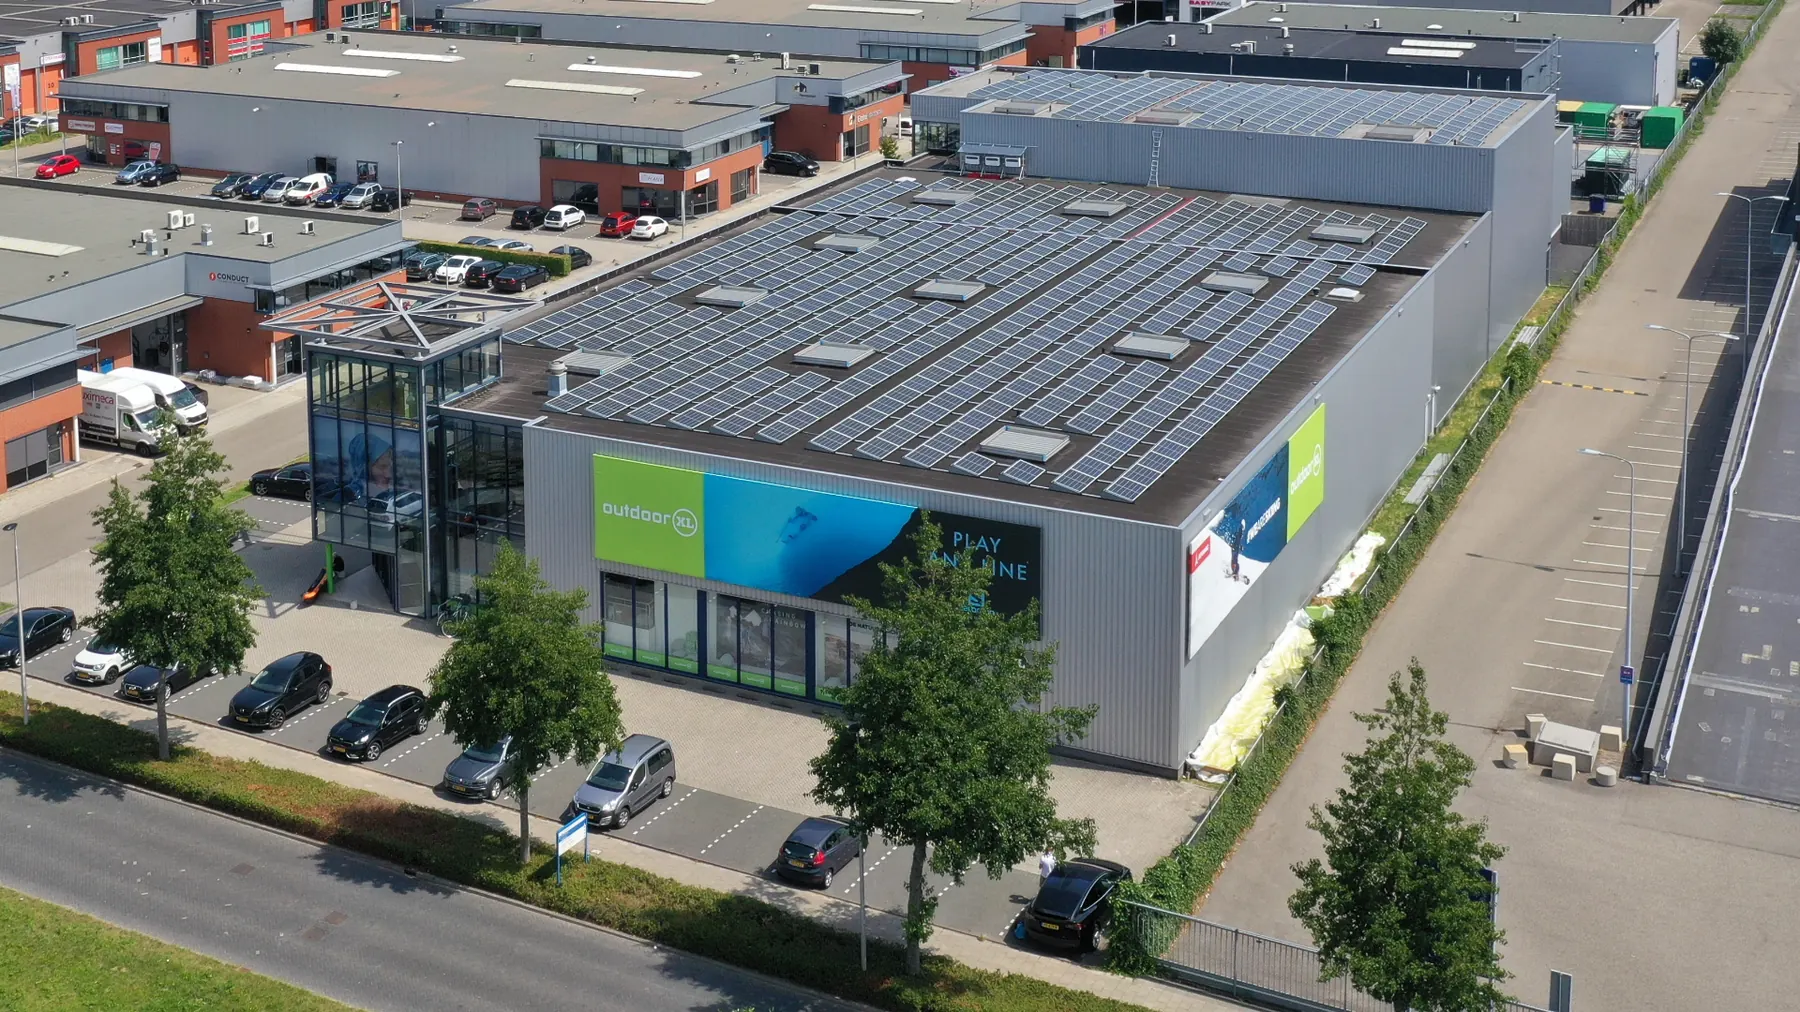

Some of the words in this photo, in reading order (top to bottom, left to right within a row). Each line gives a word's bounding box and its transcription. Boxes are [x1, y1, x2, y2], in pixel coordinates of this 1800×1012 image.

[216, 273, 249, 283] CONDUCT
[603, 502, 671, 525] outdoor
[953, 531, 1001, 553] PLAY
